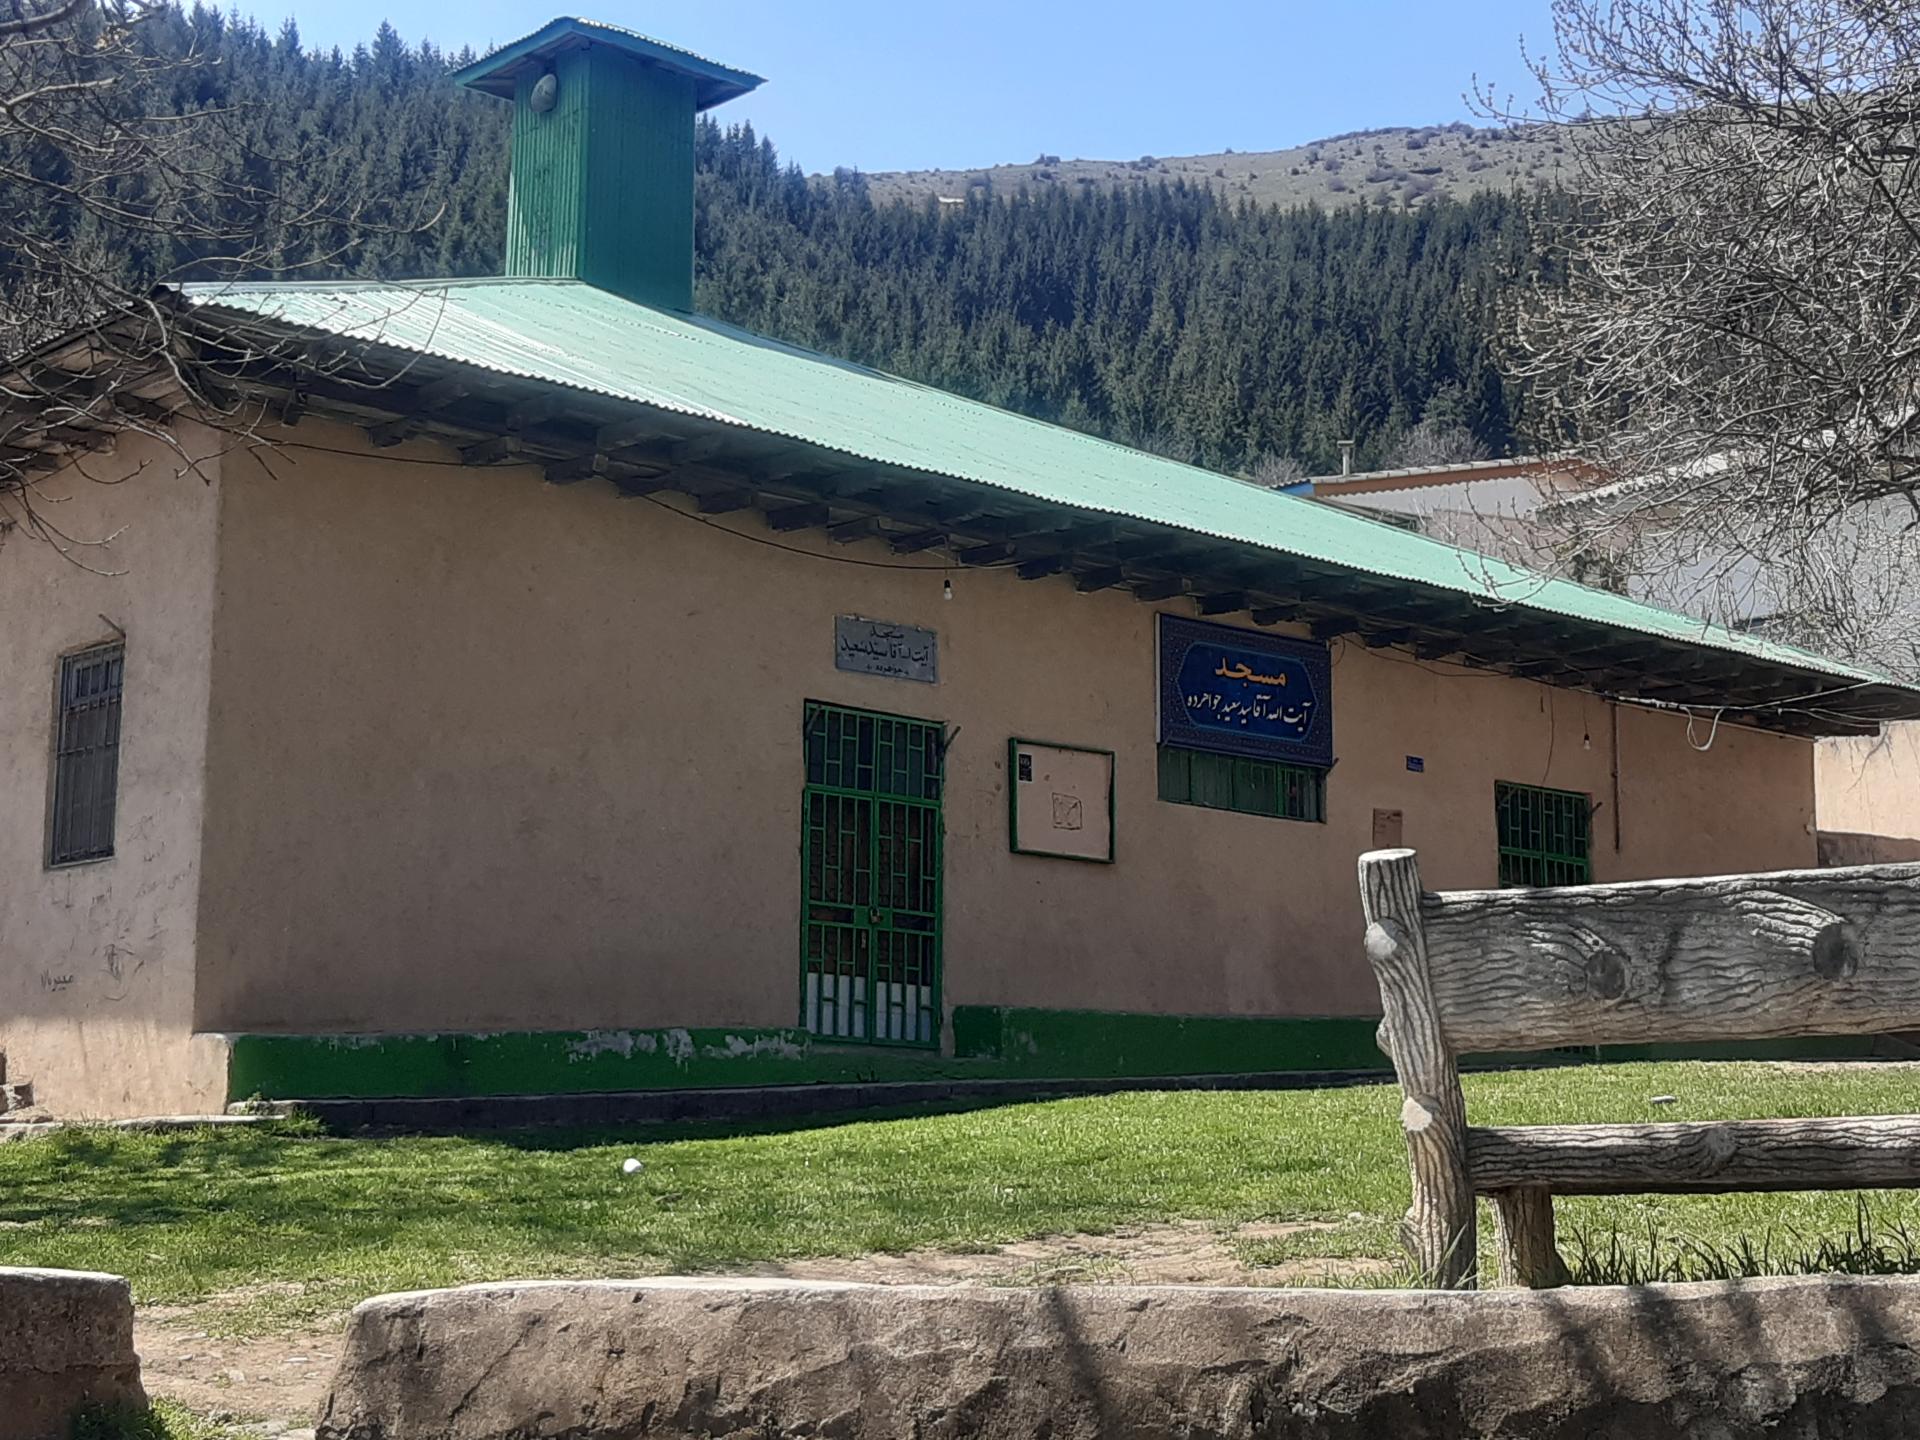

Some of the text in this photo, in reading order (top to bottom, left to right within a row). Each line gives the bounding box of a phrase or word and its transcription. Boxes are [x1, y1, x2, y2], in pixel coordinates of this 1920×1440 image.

[870, 625, 904, 641] مسجد
[841, 634, 868, 658] سعید
[889, 642, 903, 659] آقا
[912, 646, 929, 666] آیت
[1215, 656, 1287, 688] مسجد
[1187, 693, 1222, 720] جواهرده
[1221, 701, 1241, 722] سعید
[1237, 706, 1252, 725] سید
[1253, 694, 1272, 717] آقا
[1283, 701, 1312, 732] آیت
